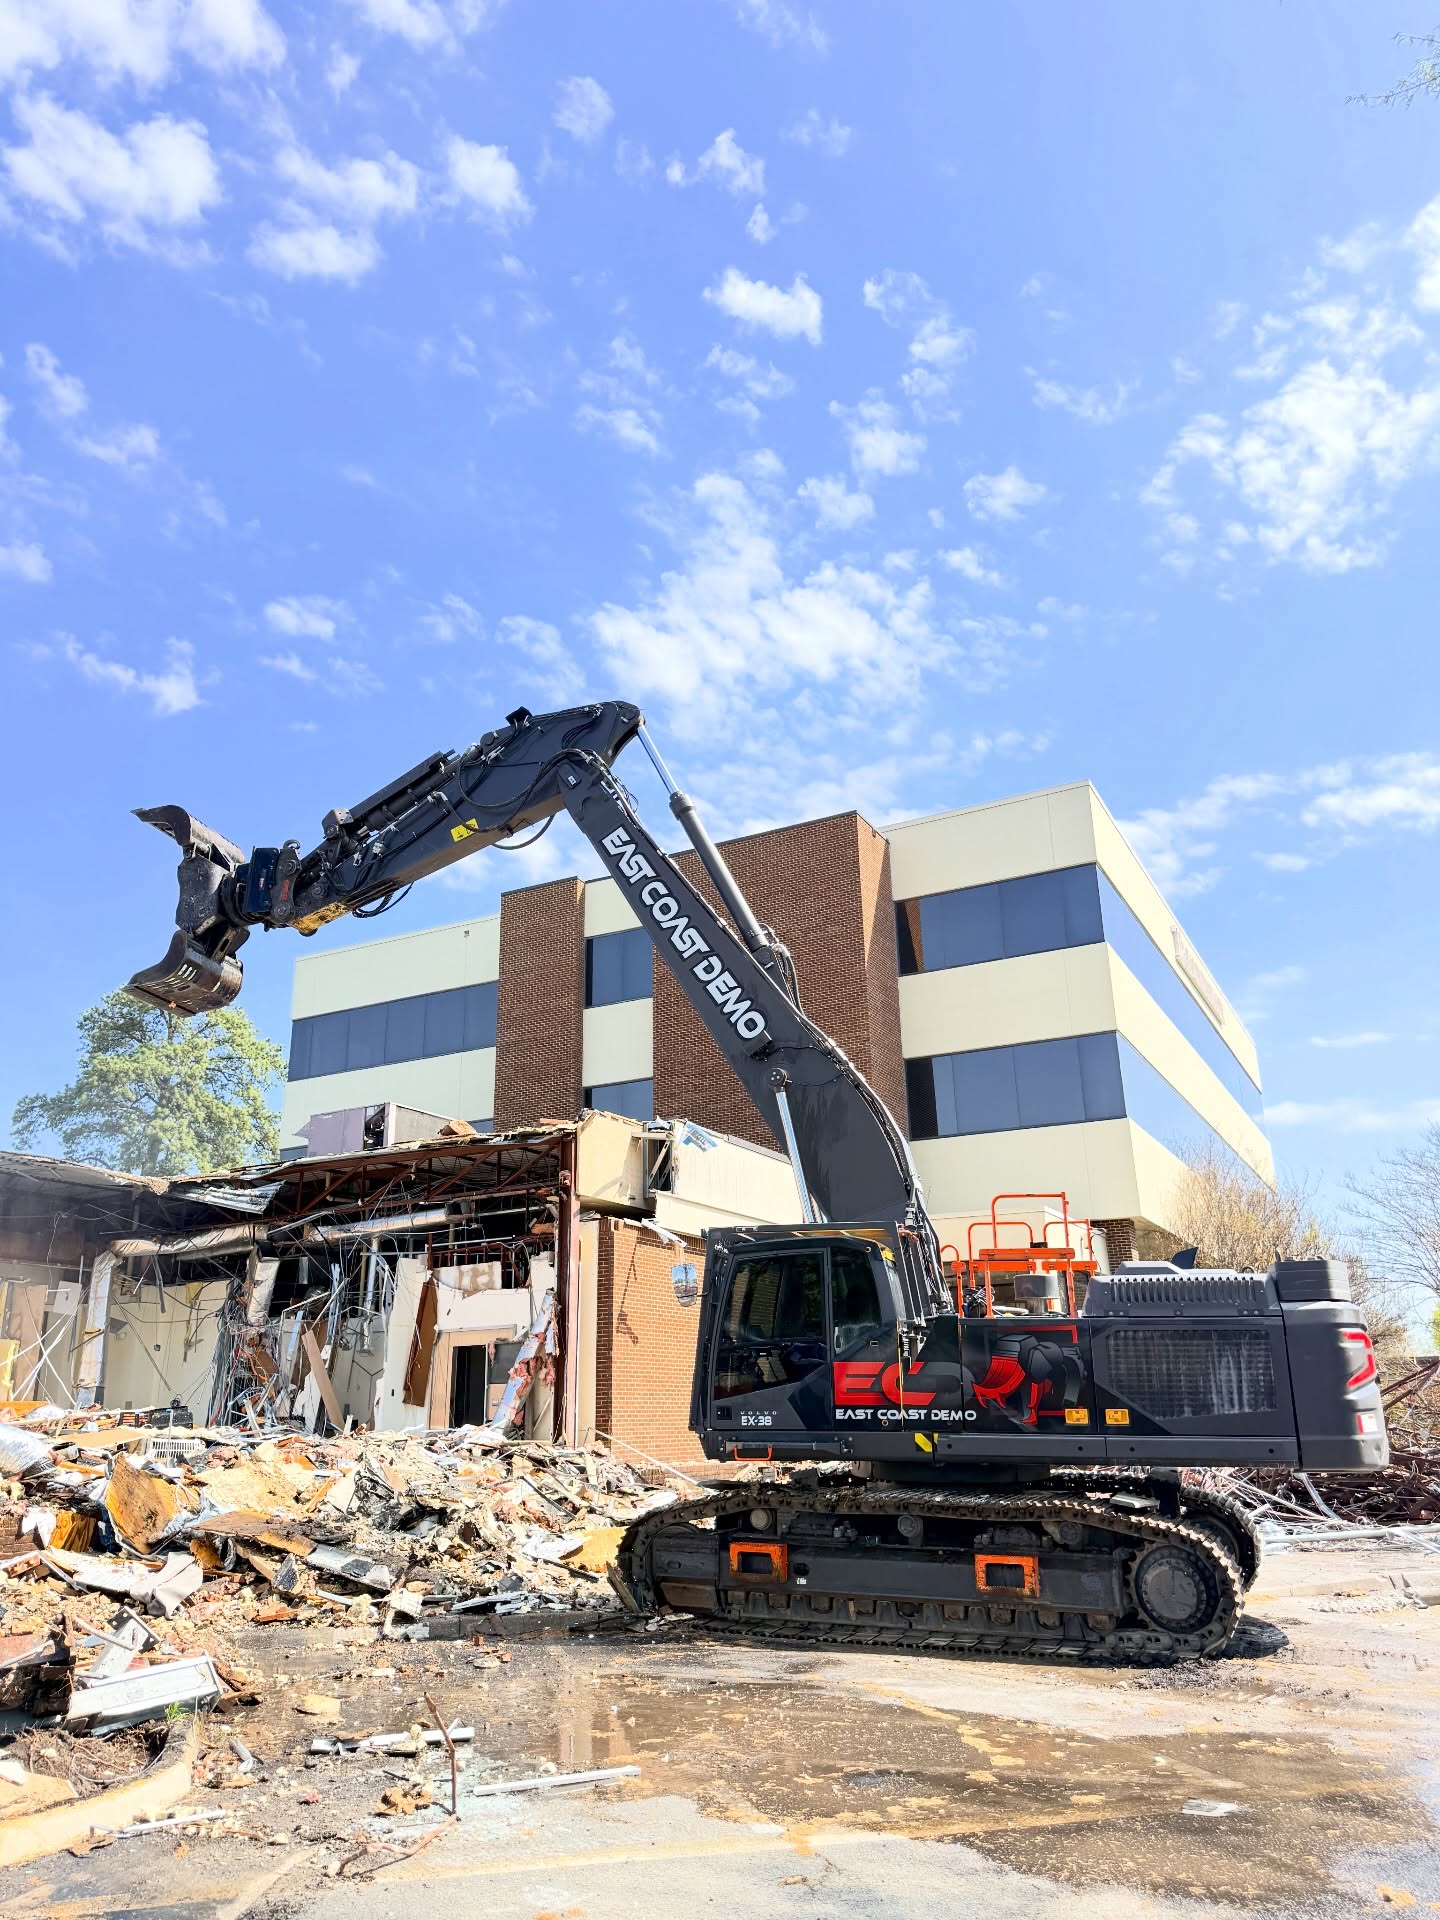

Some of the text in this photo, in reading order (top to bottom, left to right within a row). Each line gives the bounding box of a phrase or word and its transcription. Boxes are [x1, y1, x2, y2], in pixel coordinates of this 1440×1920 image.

[601, 826, 766, 1040] EAST COAST DEMO
[741, 1415, 773, 1426] EX-38
[835, 1408, 977, 1421] EAST COAST DEMO
